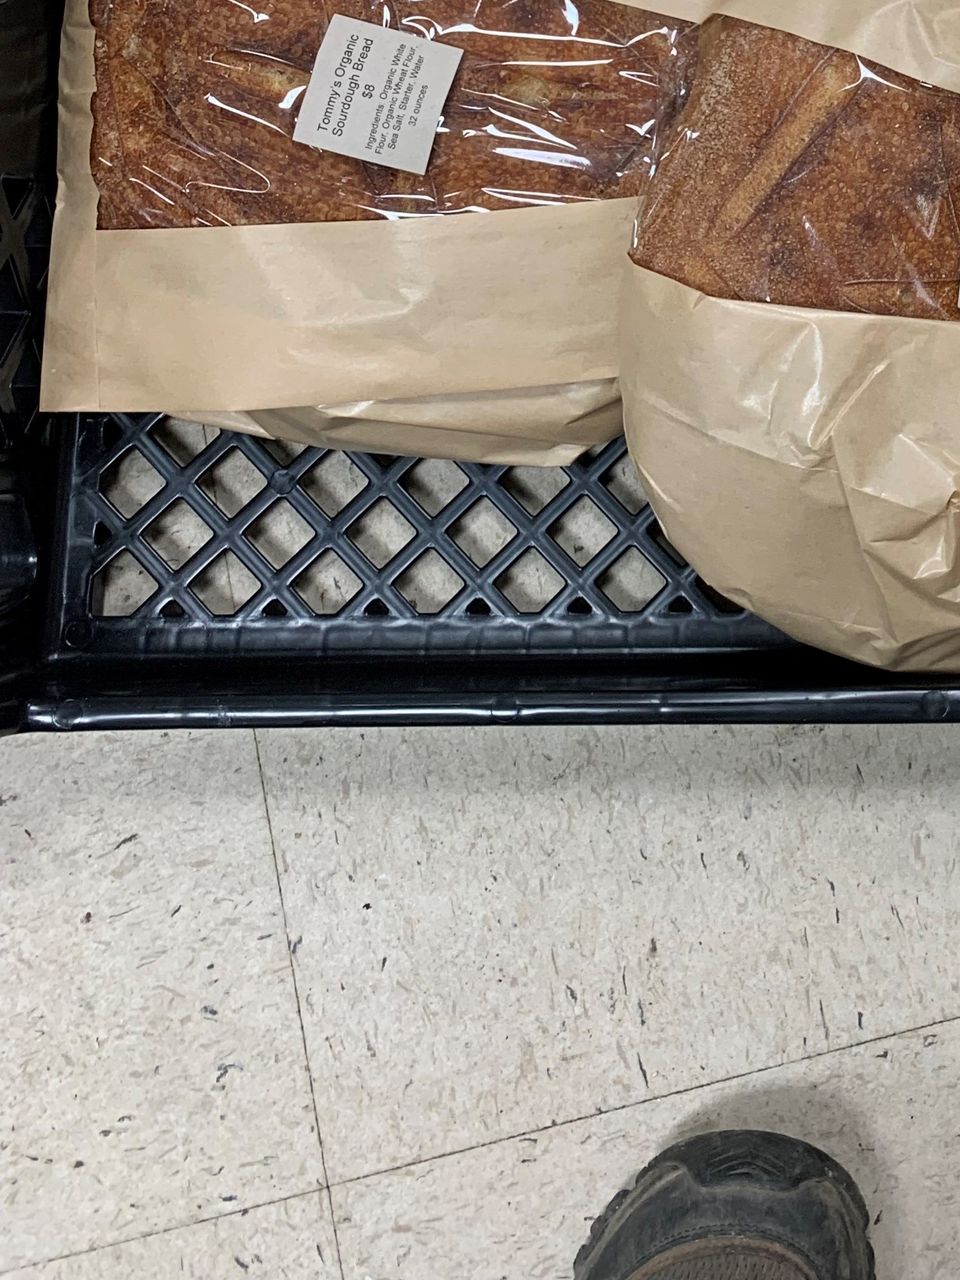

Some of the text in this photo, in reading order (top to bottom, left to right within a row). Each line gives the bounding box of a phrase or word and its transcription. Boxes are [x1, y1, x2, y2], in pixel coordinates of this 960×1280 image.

[317, 34, 359, 132] Tommy's Organic
[332, 38, 373, 137] Sourdough Bread
[363, 83, 375, 99] $8
[380, 69, 397, 99] Organic
[392, 43, 406, 67] White
[382, 97, 398, 130] Organic
[394, 69, 409, 96] Wheat
[388, 134, 399, 149] Sea
[409, 55, 424, 79] Water
[409, 85, 428, 126] 32 ounces
